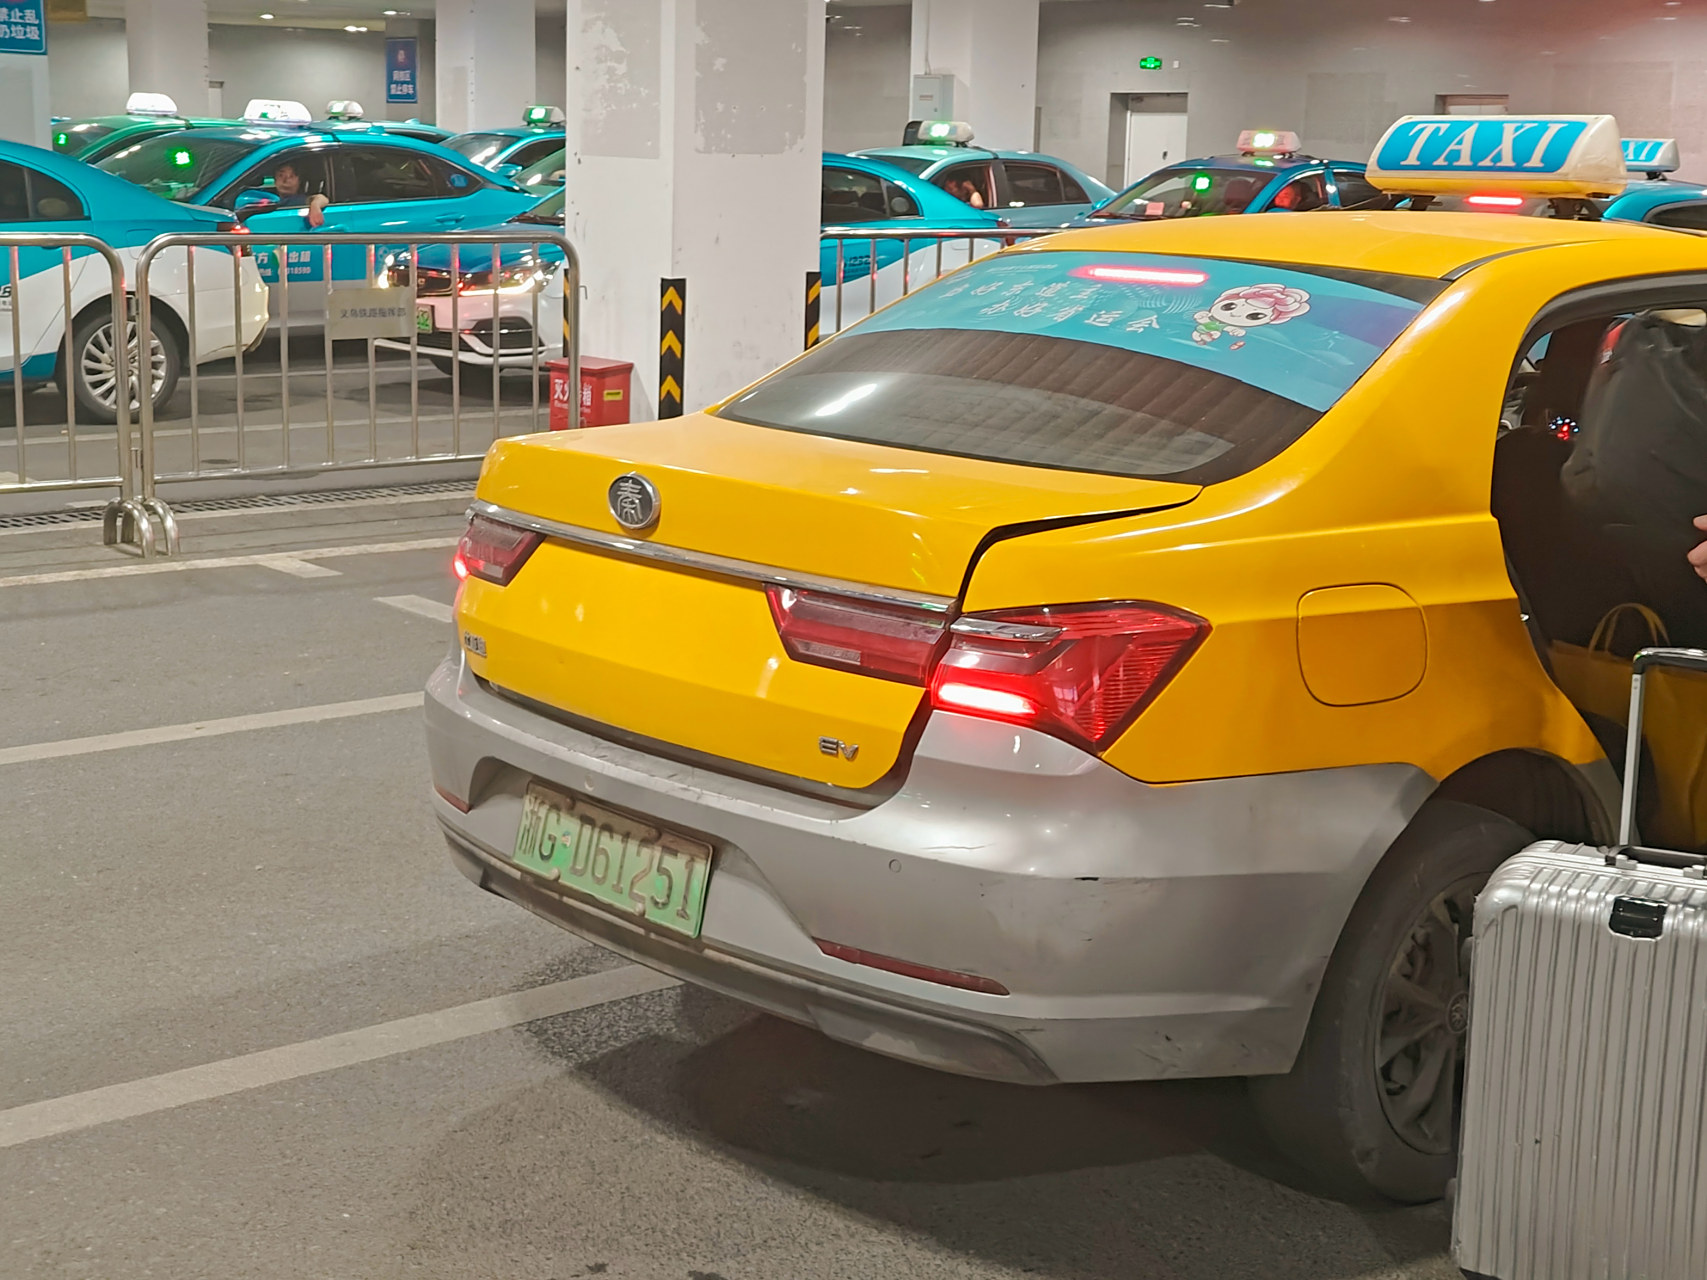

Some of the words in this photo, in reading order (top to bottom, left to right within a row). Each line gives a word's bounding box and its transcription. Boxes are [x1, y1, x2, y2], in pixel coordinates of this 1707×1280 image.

[1400, 123, 1569, 168] TAXI
[288, 251, 311, 263] 出租
[980, 299, 1160, 333] 办好省运会
[818, 735, 860, 761] EV
